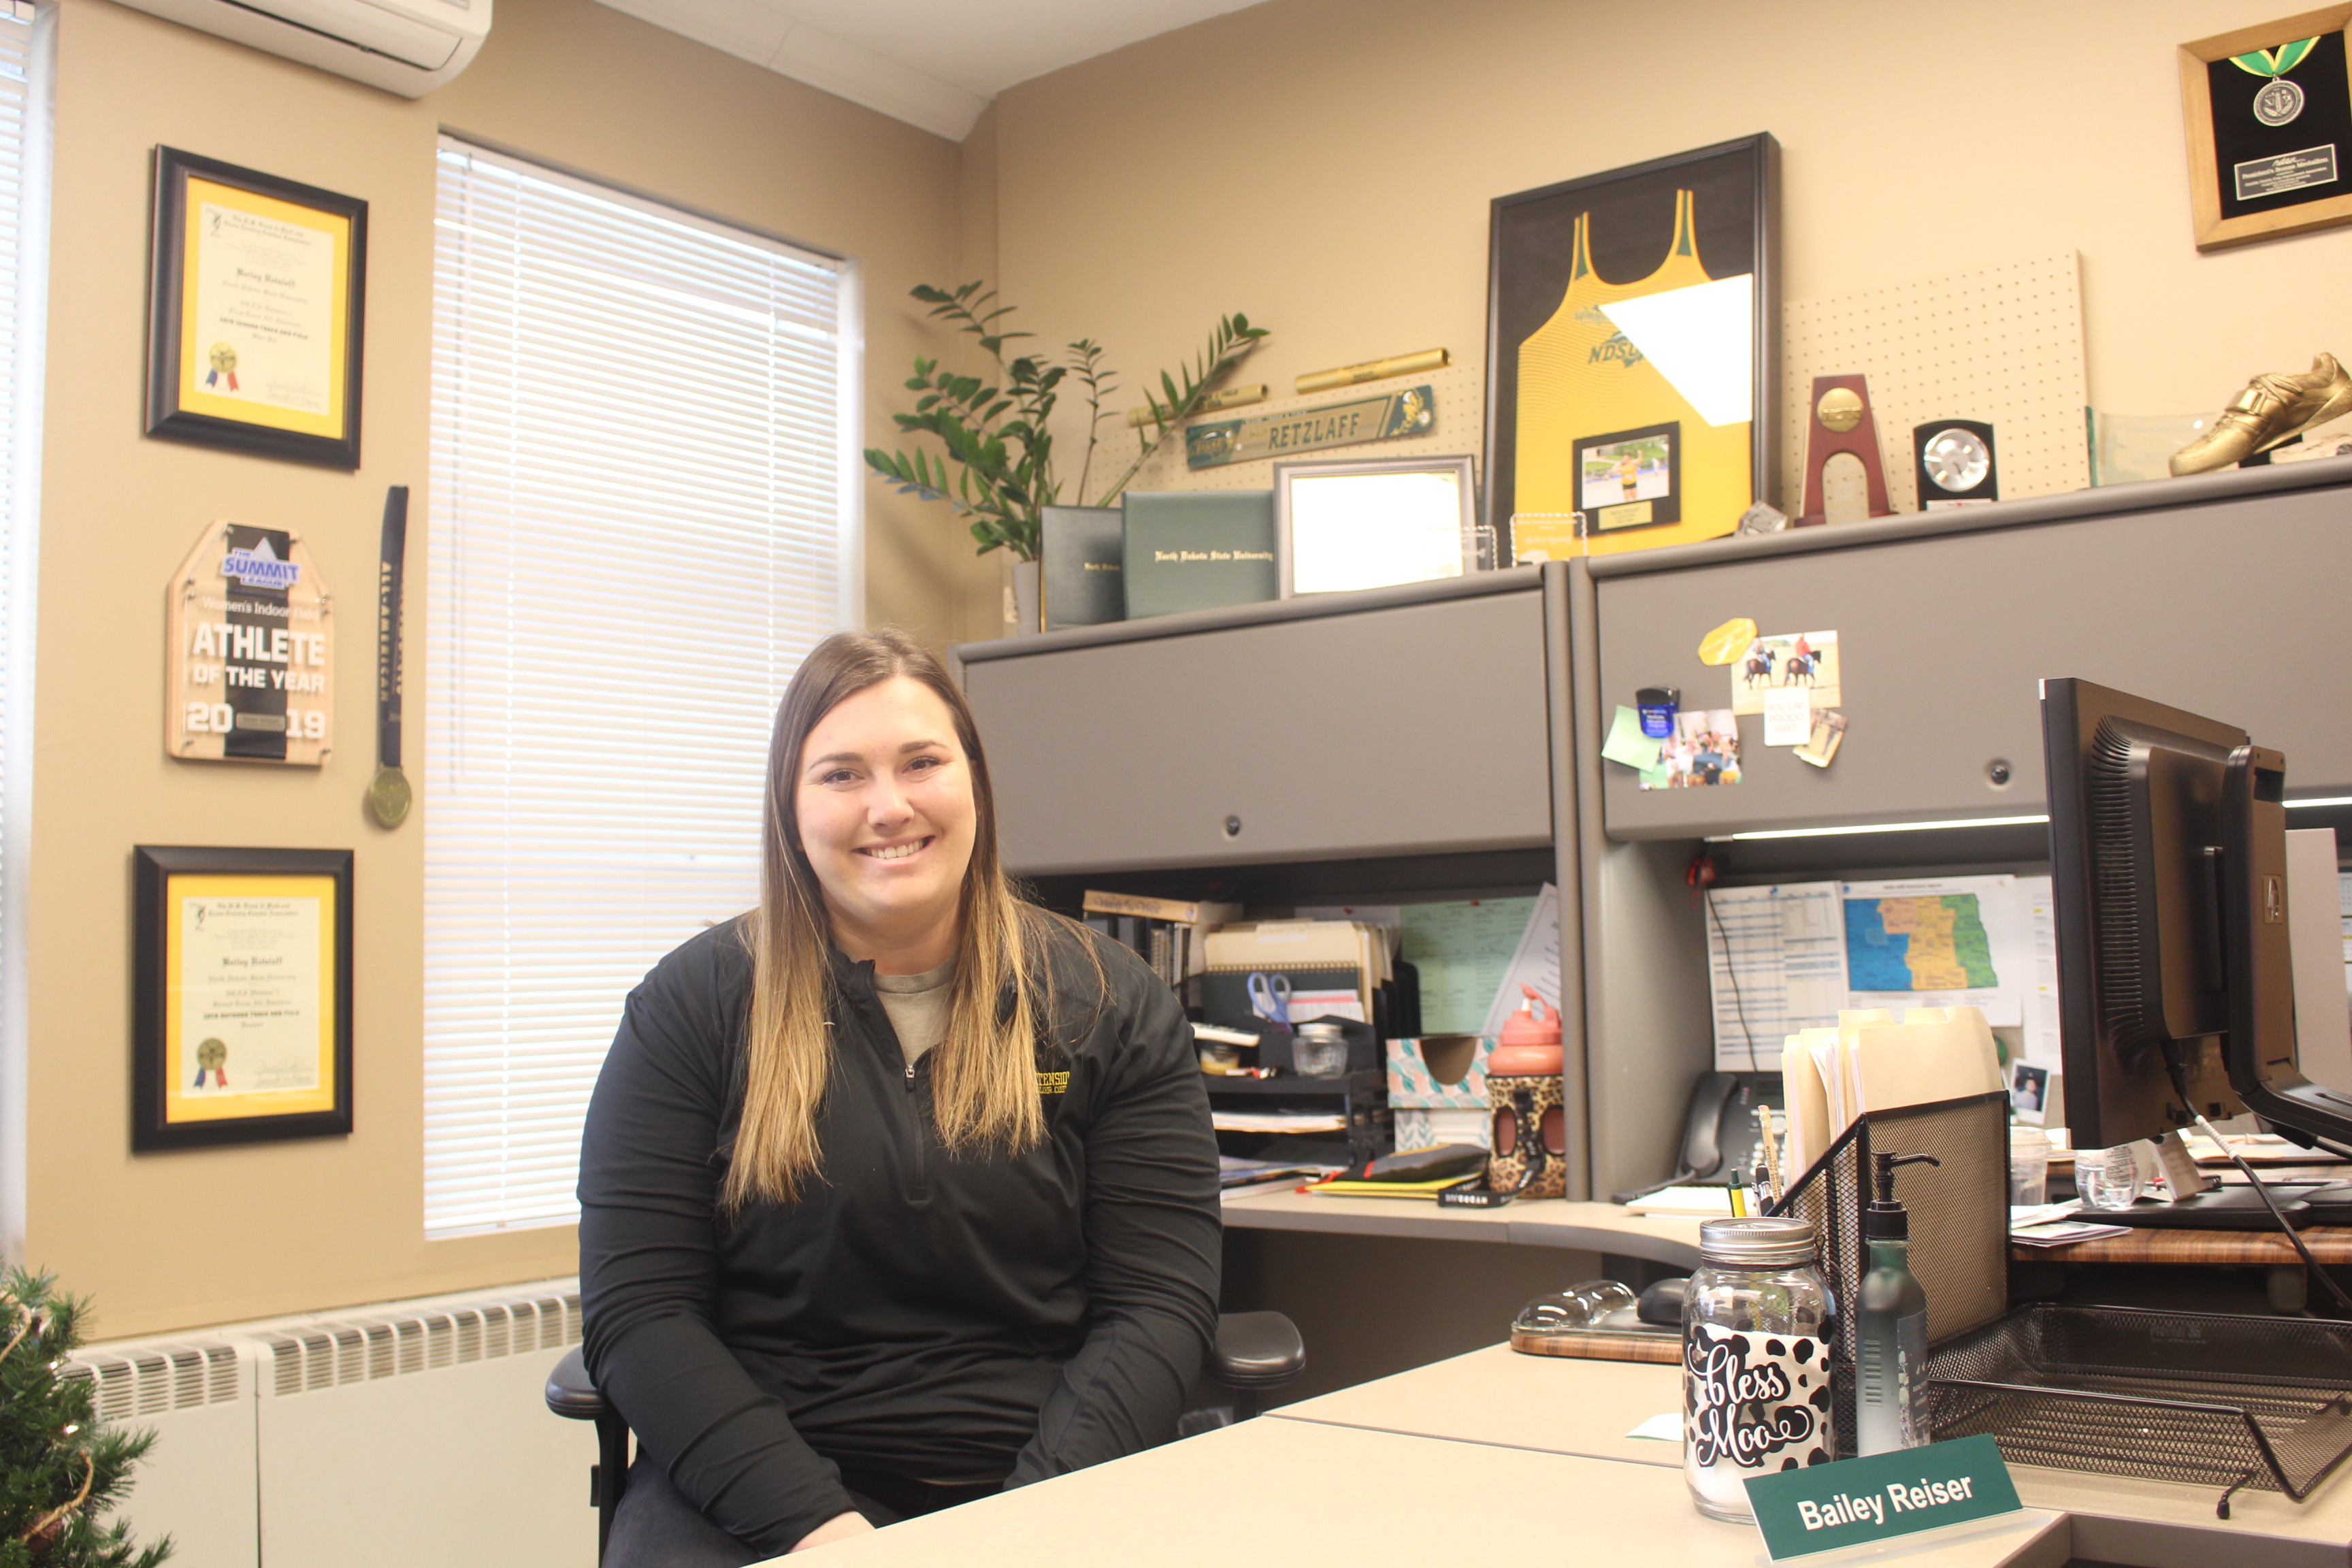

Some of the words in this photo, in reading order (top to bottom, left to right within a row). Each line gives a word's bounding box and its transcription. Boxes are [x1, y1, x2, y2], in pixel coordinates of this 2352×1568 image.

[1588, 340, 1641, 364] NDSU
[1268, 412, 1360, 450] RETZLAFF
[224, 557, 299, 581] SUMMIT
[1155, 550, 1178, 563] North
[1179, 550, 1208, 562] Dakota
[1232, 550, 1274, 561] University
[203, 596, 252, 612] Women's
[255, 601, 289, 617] Indoor
[192, 621, 326, 666] ATHLETE
[193, 664, 220, 683] OF
[225, 665, 266, 689] THE
[271, 669, 325, 692] YEAR
[186, 702, 233, 734] 20
[286, 708, 326, 739] 19
[1765, 1145, 1774, 1171] PROGRAM
[1697, 1403, 1810, 1465] Moo
[1797, 1492, 1884, 1531] Bailey
[1886, 1475, 1973, 1513] Reiser
